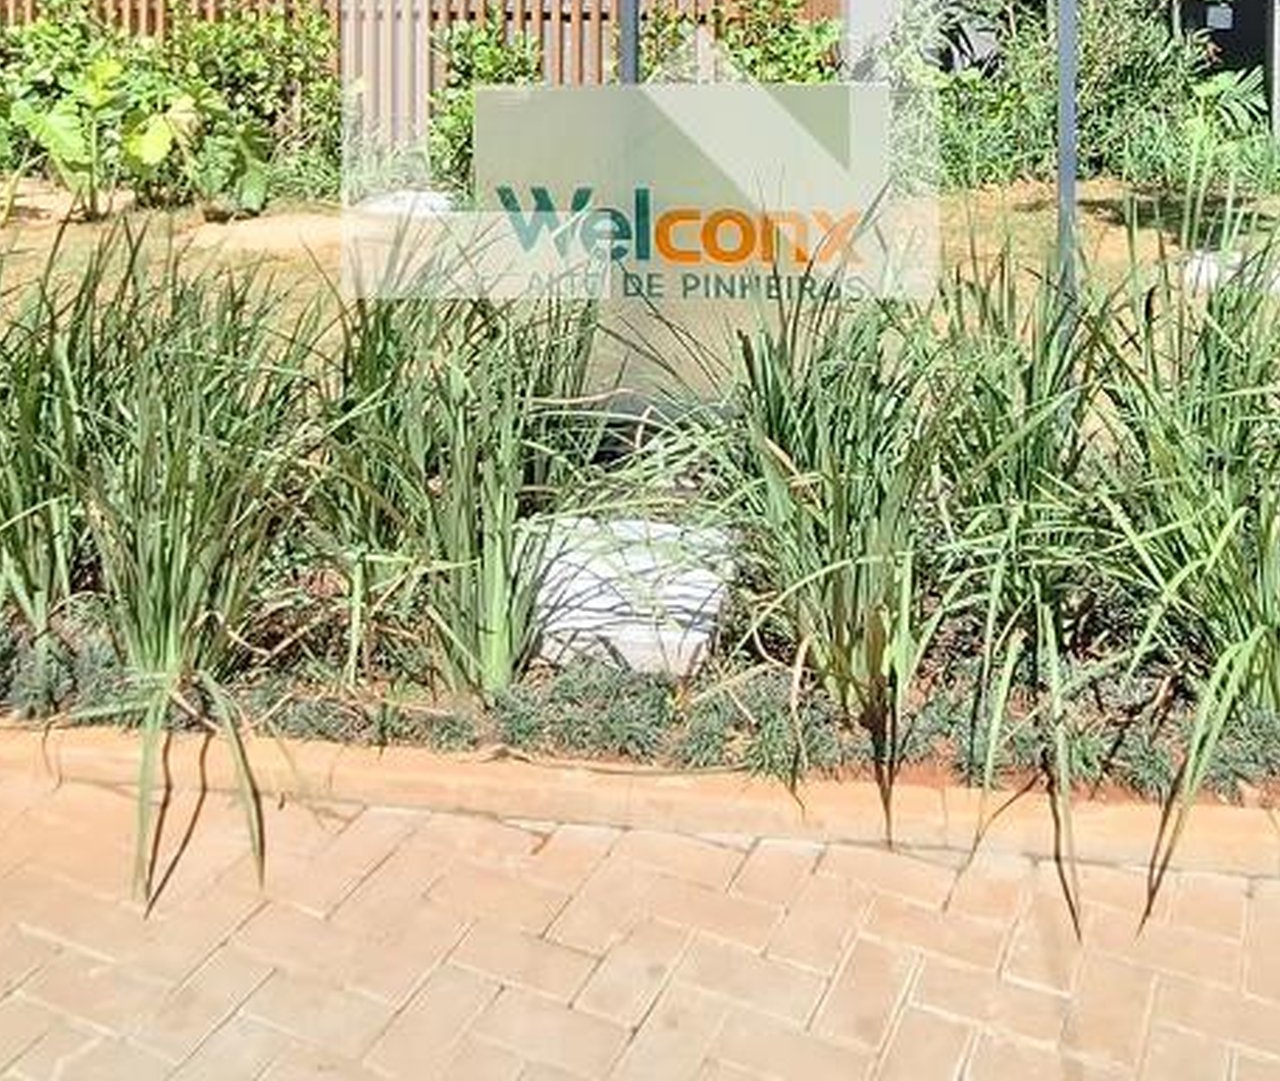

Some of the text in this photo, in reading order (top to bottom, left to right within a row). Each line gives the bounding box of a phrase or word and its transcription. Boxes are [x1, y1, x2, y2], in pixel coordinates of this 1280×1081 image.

[496, 185, 864, 267] Welconx
[623, 273, 664, 300] DE
[682, 273, 866, 302] PINHEIROS
